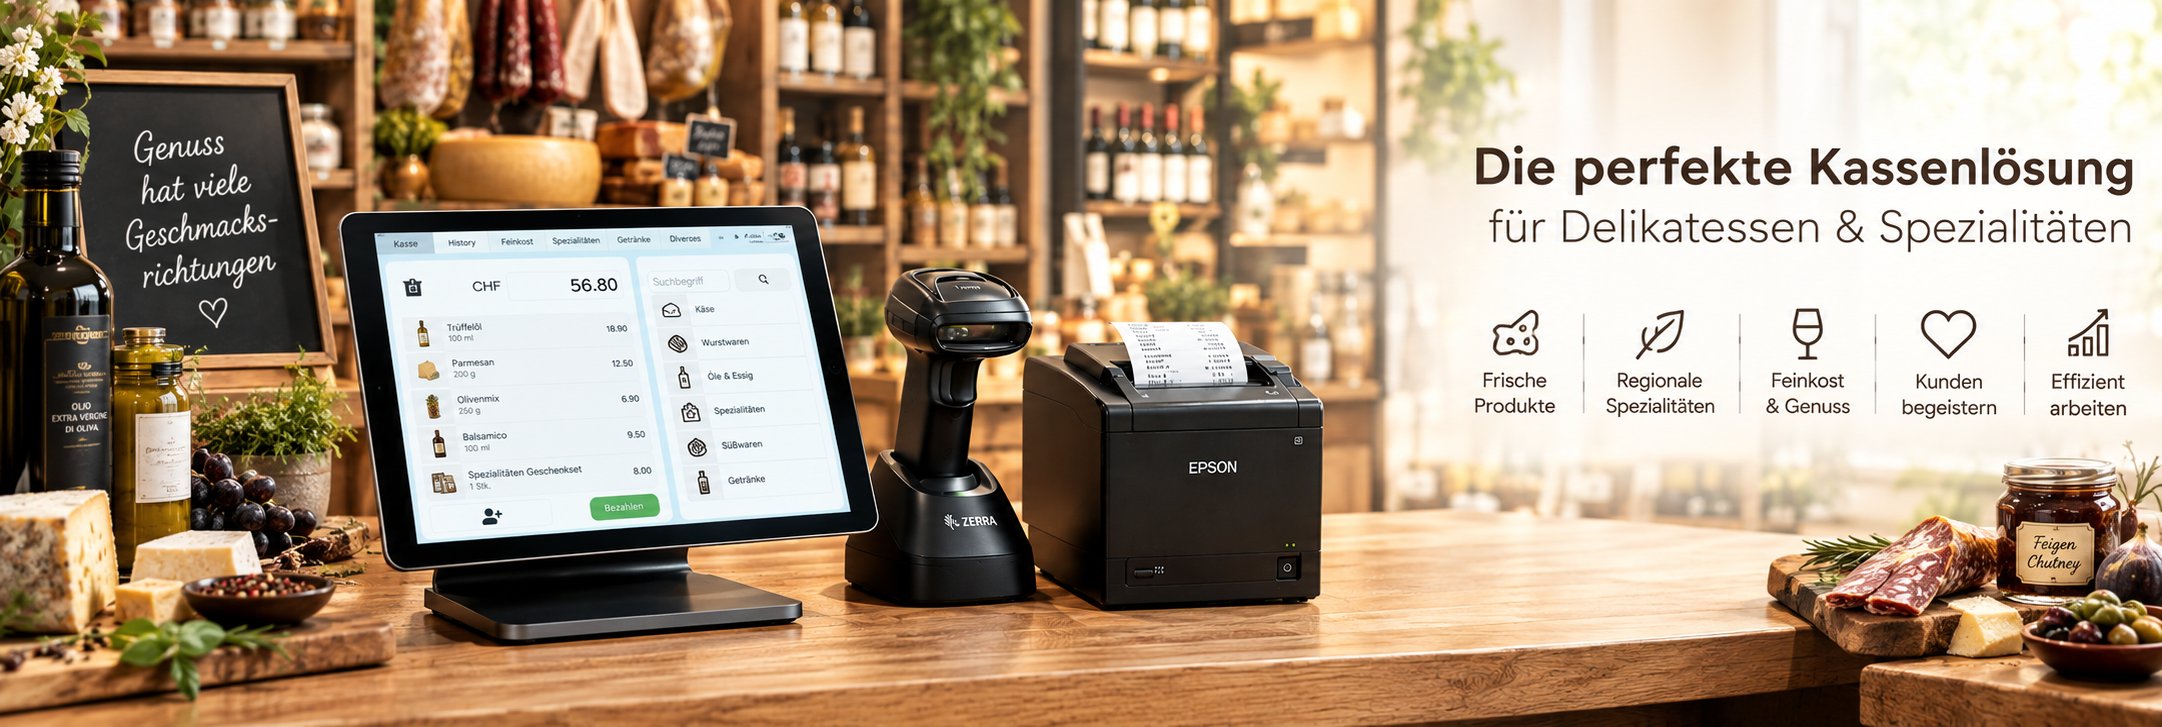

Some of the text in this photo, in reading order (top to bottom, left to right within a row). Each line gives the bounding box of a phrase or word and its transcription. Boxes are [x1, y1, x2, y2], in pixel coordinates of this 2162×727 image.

[134, 130, 224, 166] Genuss
[142, 164, 251, 204] hat viele
[126, 204, 278, 253] Geschmacks-
[552, 237, 600, 246] Spezialitäten
[143, 254, 276, 289] richtungen
[473, 278, 617, 292] CHF 56.80
[653, 276, 703, 288] Suchbegriff
[447, 323, 482, 331] Trüffelöl
[452, 359, 494, 367] Parmesan
[454, 370, 475, 379] 200 g
[724, 372, 730, 380] &
[732, 371, 753, 381] Essig
[457, 395, 499, 404] Olivenmix
[622, 395, 639, 403] 6.90
[714, 406, 765, 416] Spezialitäten
[52, 414, 78, 422] EXTRA
[76, 424, 99, 432] OLIVA
[463, 432, 507, 441] Balsamico
[633, 467, 652, 475] 8.00
[1189, 461, 1237, 474] EPSON
[468, 469, 524, 480] Spezialitäten
[728, 476, 765, 484] Getränke
[604, 503, 643, 512] Bezahlen
[962, 516, 997, 526] ZERRA
[2034, 535, 2077, 555] Feigen
[2028, 555, 2081, 575] Chutney
